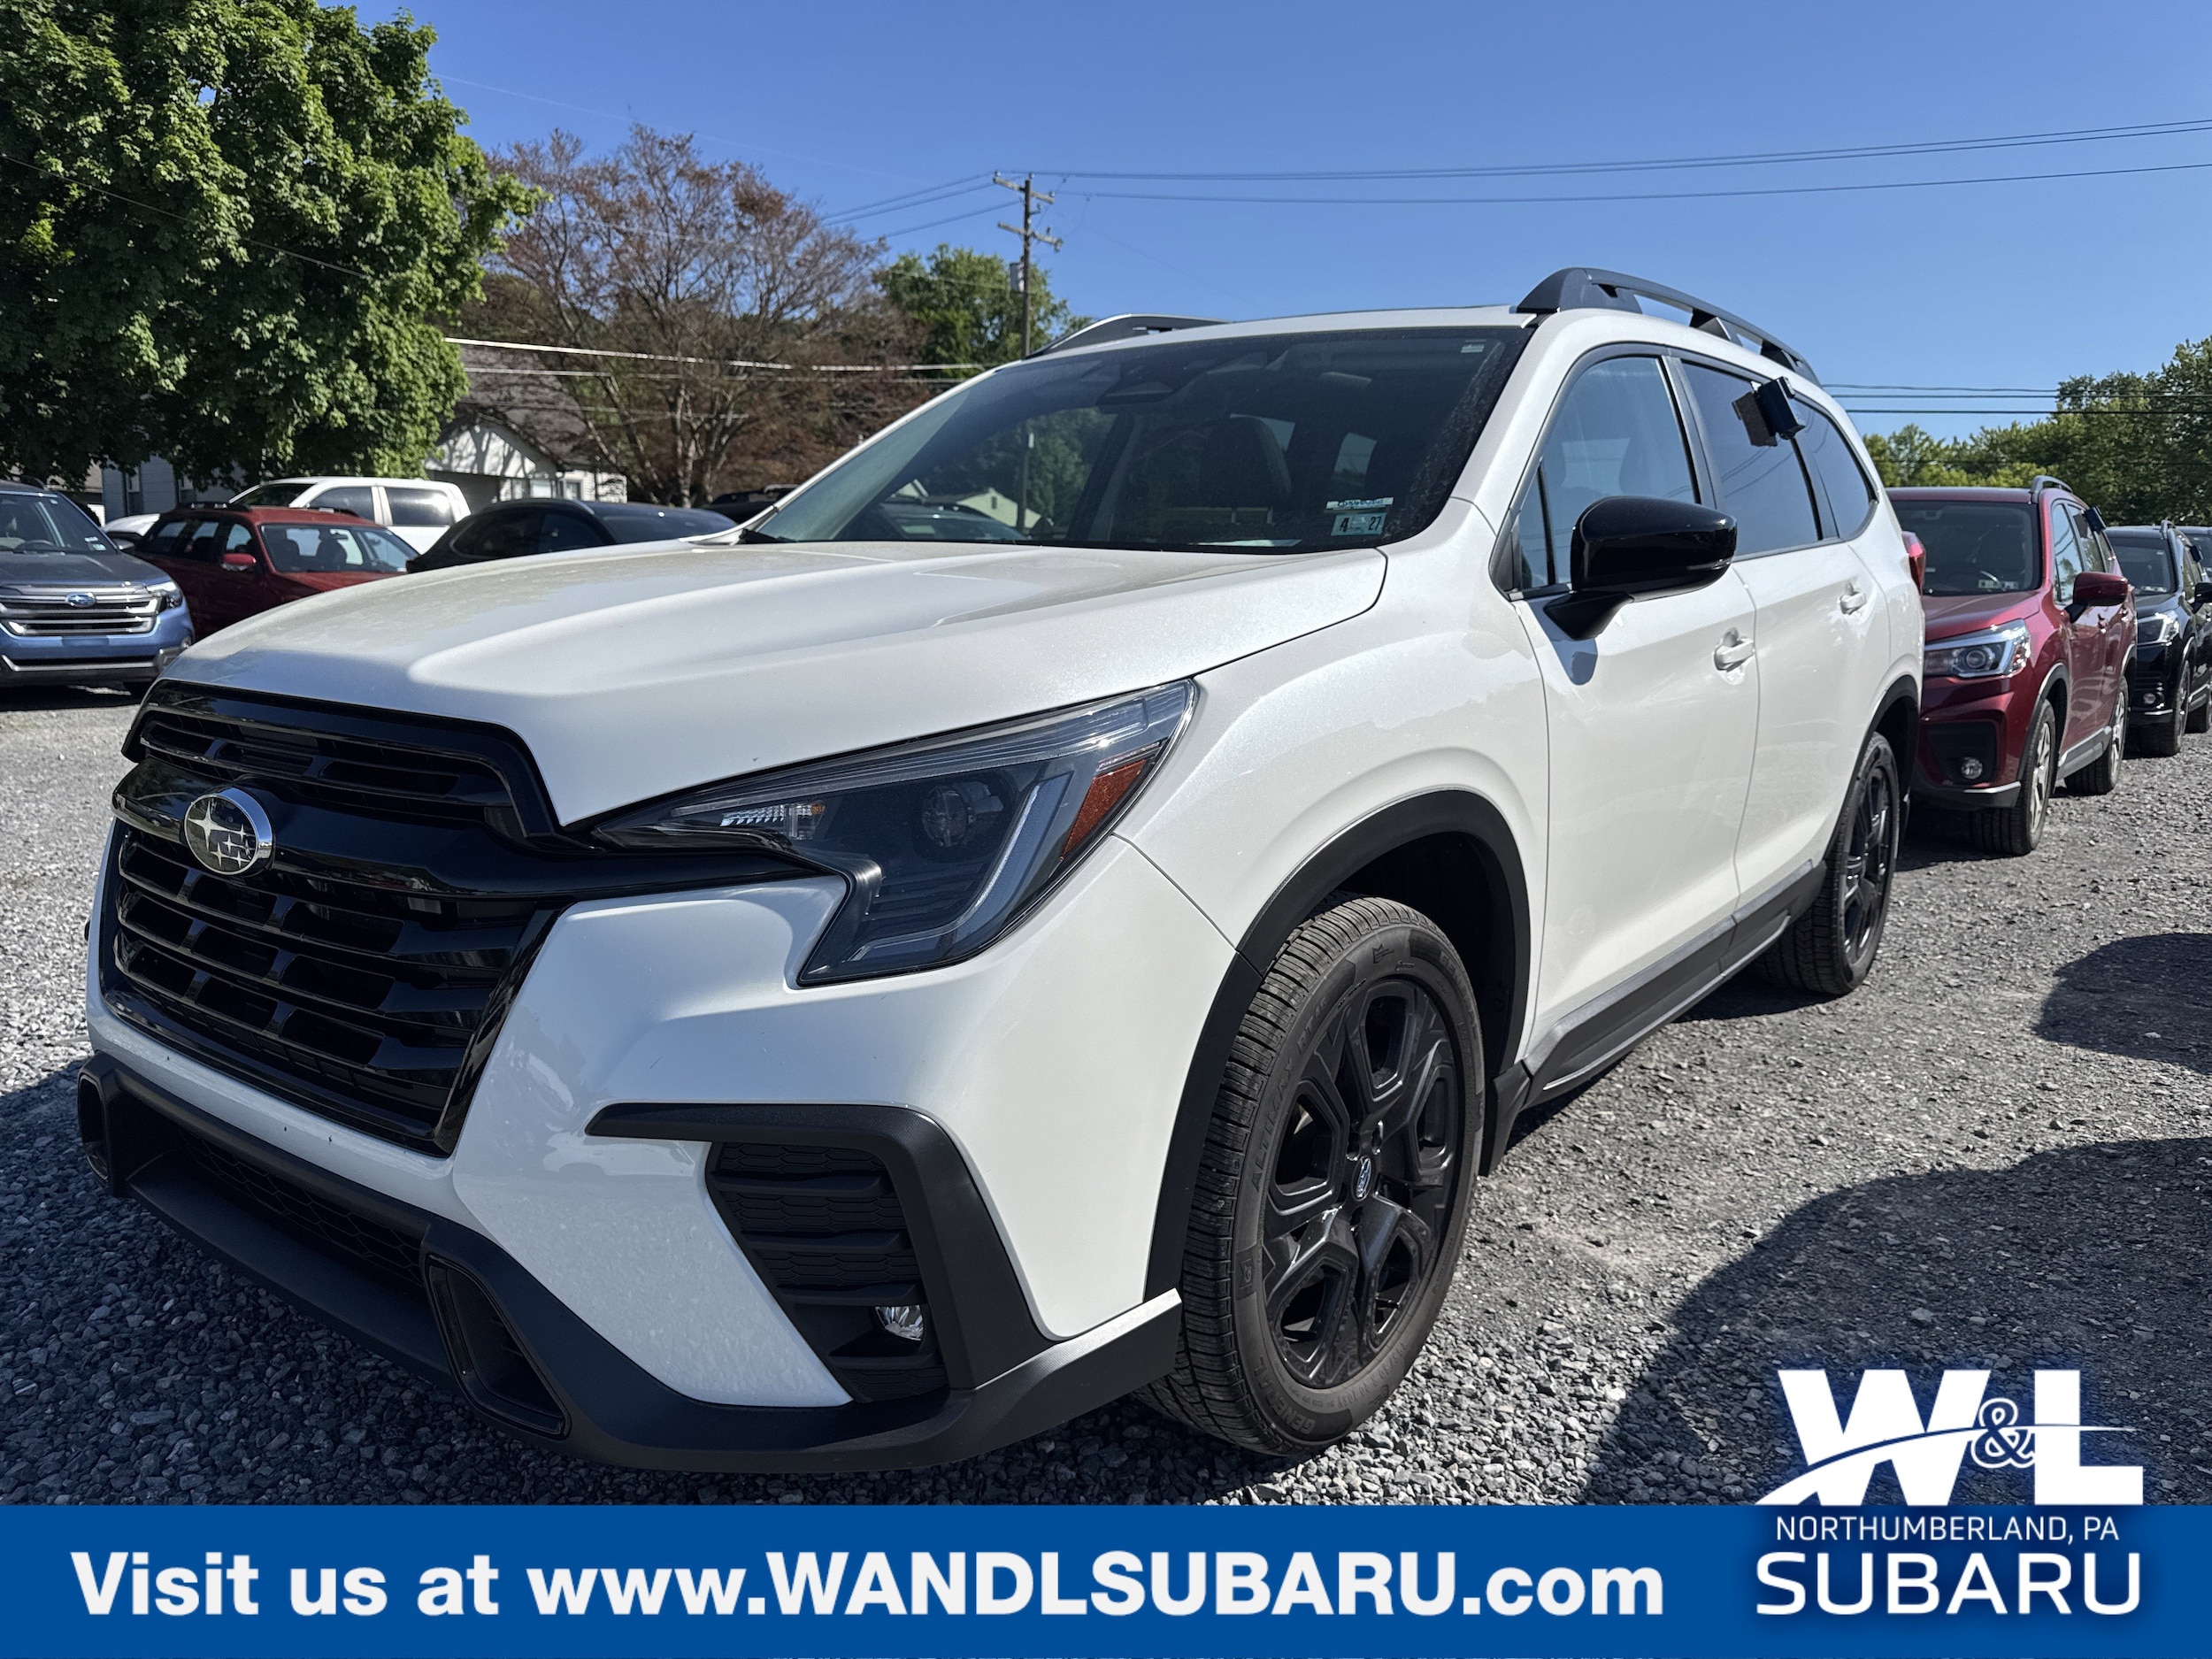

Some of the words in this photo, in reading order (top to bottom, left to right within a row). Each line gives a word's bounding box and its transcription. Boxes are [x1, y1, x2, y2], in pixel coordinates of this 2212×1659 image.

[1339, 517, 1350, 533] 4
[1368, 516, 1382, 531] 27
[1251, 1056, 1294, 1194] ALTIMAX
[1253, 1356, 1317, 1435] GENERAL
